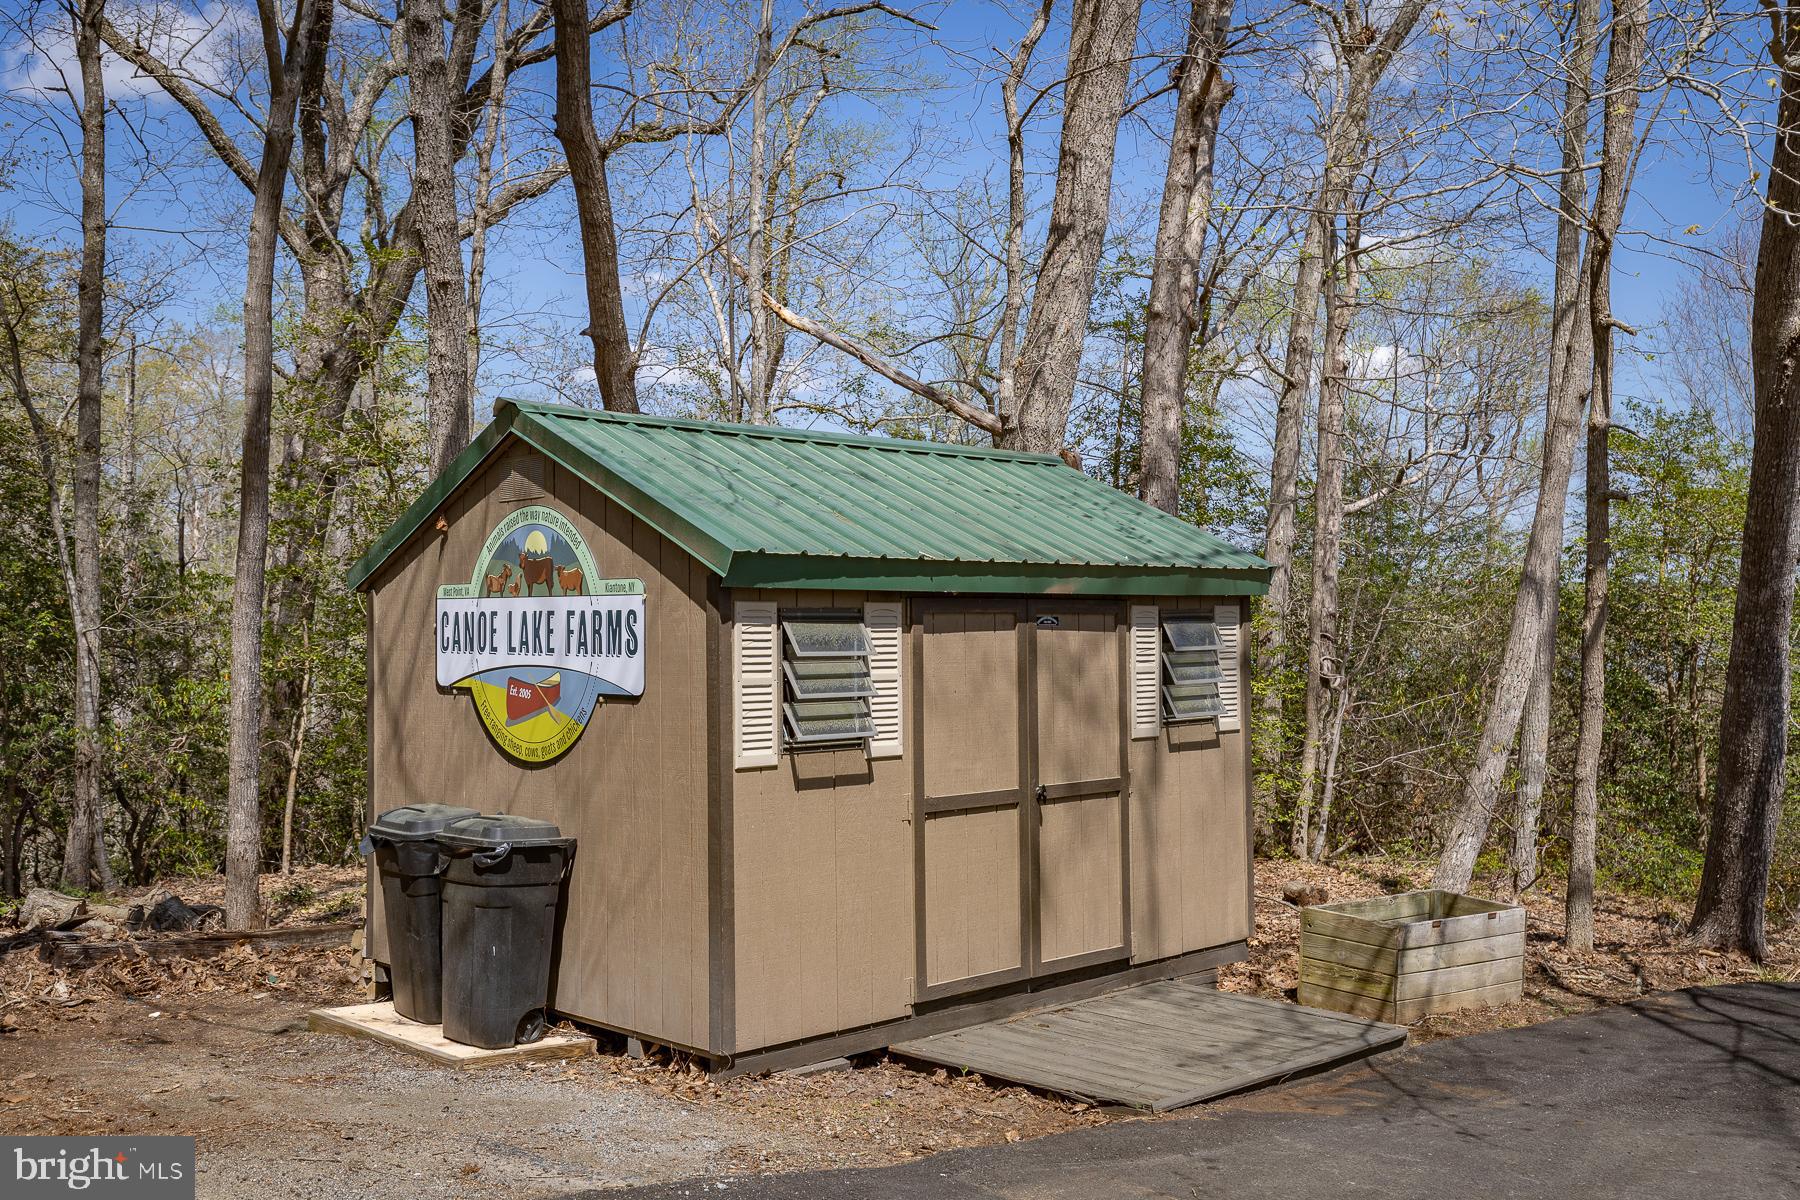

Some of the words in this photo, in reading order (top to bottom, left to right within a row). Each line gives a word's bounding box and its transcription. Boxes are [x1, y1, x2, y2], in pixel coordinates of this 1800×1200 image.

[520, 510, 529, 522] the
[530, 510, 540, 523] way
[541, 511, 560, 527] nature
[559, 517, 582, 550] intended
[443, 587, 454, 597] West
[628, 581, 636, 593] NY
[440, 610, 498, 655] CANOE
[507, 610, 555, 656] LAKE
[565, 609, 639, 658] FARMS
[509, 684, 518, 697] Est.
[518, 687, 532, 700] 2005
[540, 741, 557, 760] goats
[555, 732, 567, 750] and
